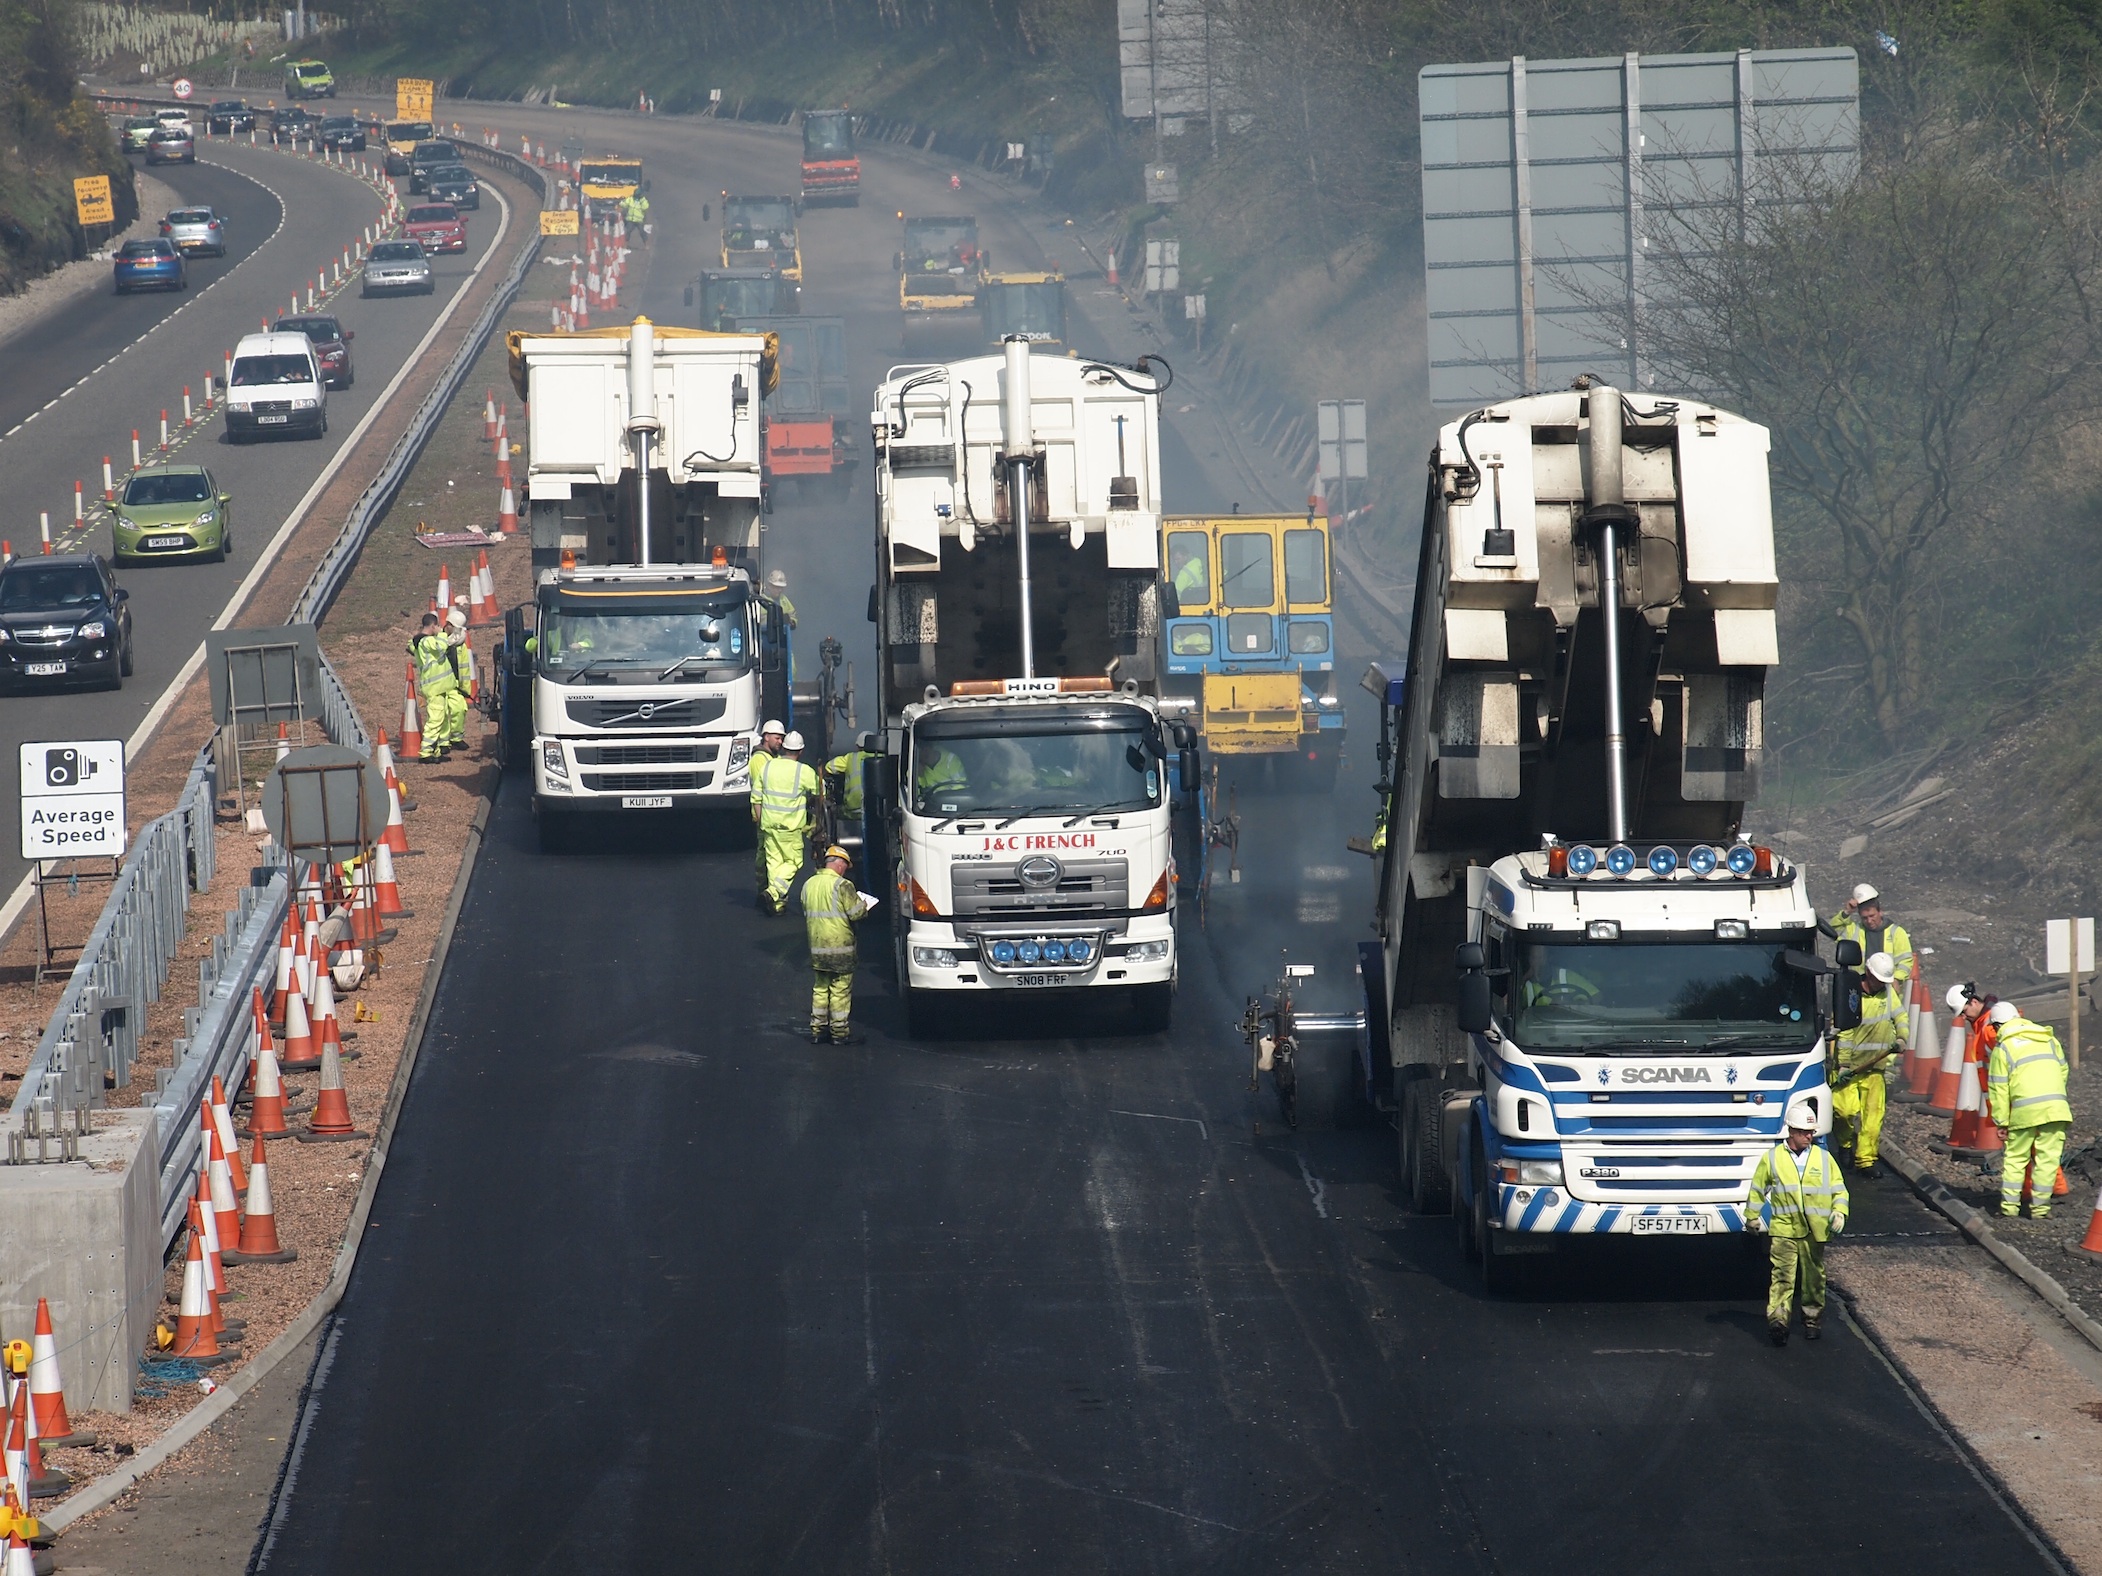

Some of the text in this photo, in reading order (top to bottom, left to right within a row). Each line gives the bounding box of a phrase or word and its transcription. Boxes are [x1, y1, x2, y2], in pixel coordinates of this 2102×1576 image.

[176, 84, 190, 92] 40
[31, 664, 46, 672] Y25
[1008, 683, 1056, 691] HINO
[649, 797, 666, 806] JYF
[31, 809, 115, 825] Average
[42, 827, 105, 846] Speed
[1025, 834, 1095, 849] FRENCH
[951, 853, 993, 861] HINO
[1017, 974, 1067, 986] SN08 FRF
[1621, 1067, 1712, 1084] SCANIA
[1638, 1218, 1701, 1231] SF57 FTX
